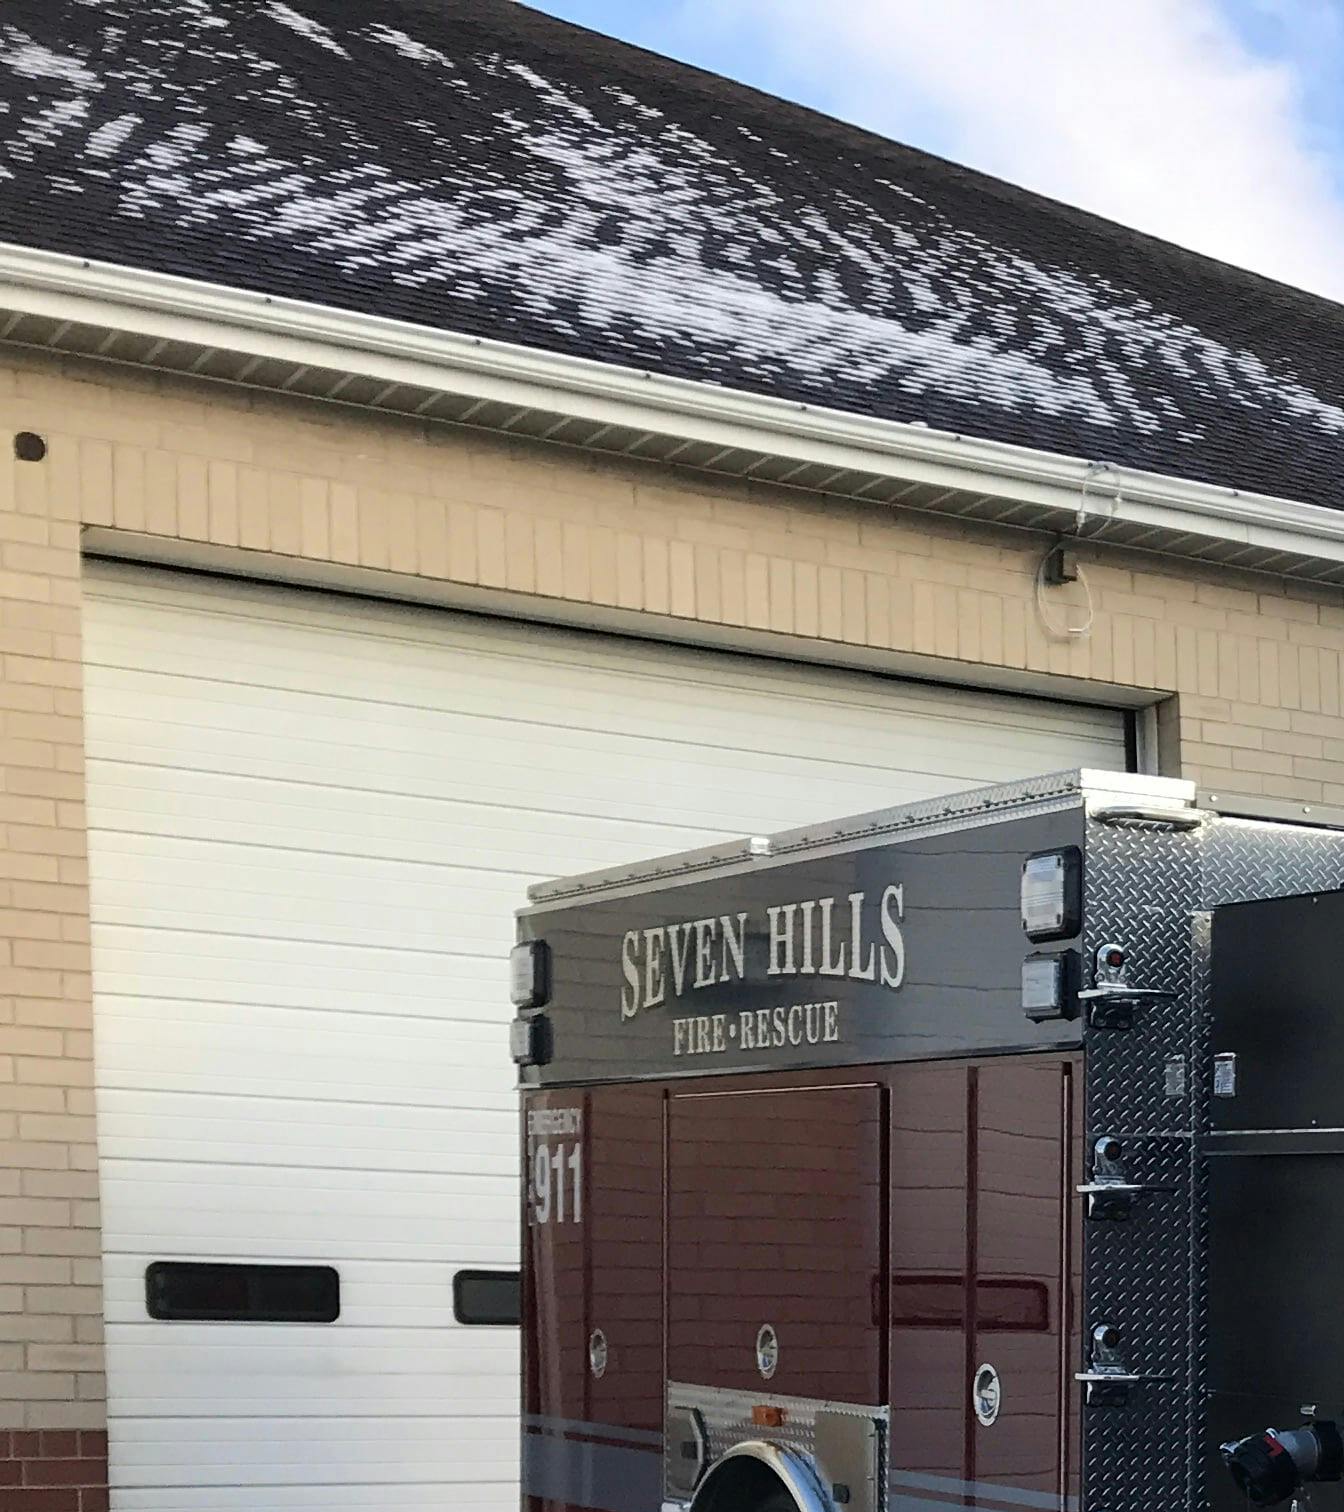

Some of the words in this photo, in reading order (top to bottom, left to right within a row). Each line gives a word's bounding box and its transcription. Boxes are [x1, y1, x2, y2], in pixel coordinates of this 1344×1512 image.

[620, 912, 748, 1022] SEVEN
[766, 883, 906, 988] HILLS
[535, 1142, 581, 1224] 911
